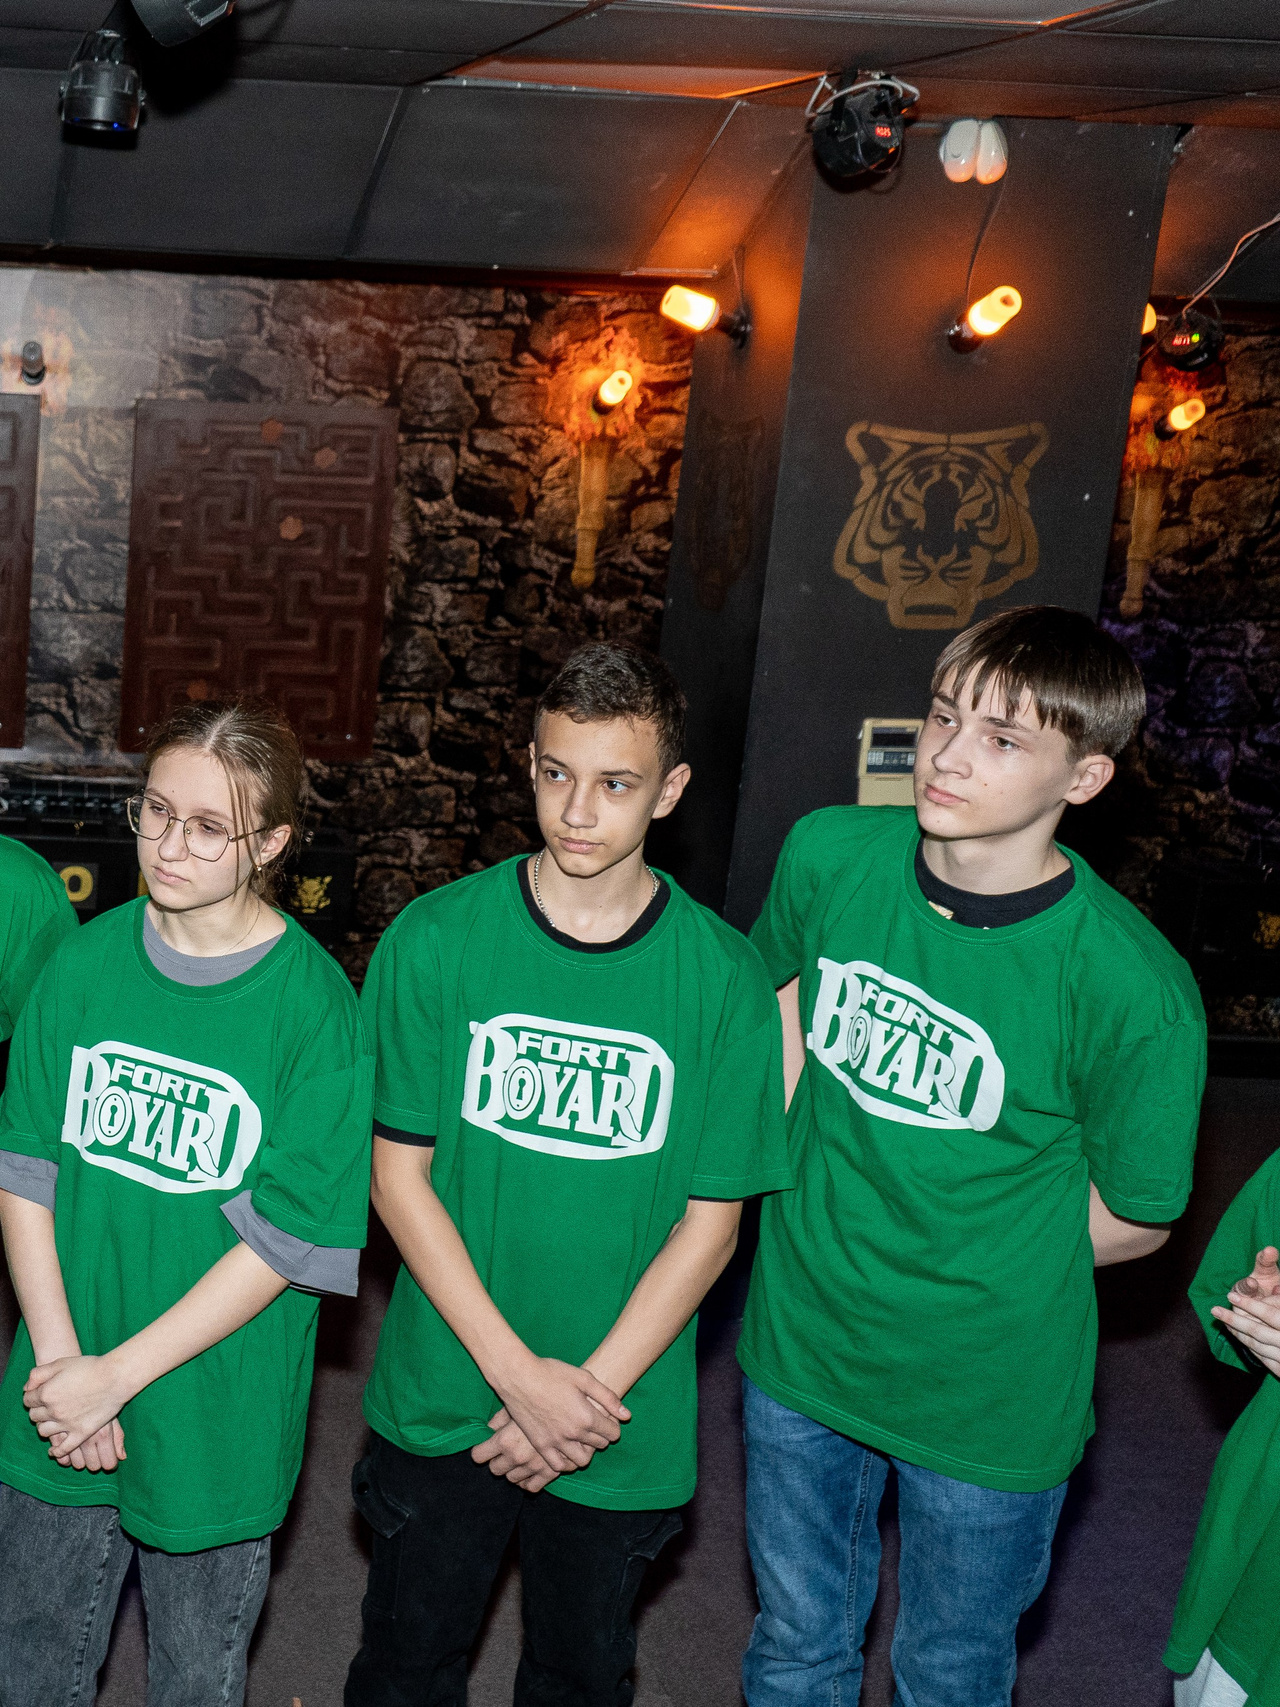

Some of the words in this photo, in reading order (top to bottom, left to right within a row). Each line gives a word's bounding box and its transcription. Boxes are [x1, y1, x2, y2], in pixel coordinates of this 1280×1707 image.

[517, 1030, 626, 1070] FORT
[806, 957, 1005, 1130] BOYARD
[861, 980, 953, 1046] FORT
[61, 1045, 262, 1184] BOYARD
[110, 1058, 207, 1105] FORT
[461, 1020, 675, 1147] BOYARD
